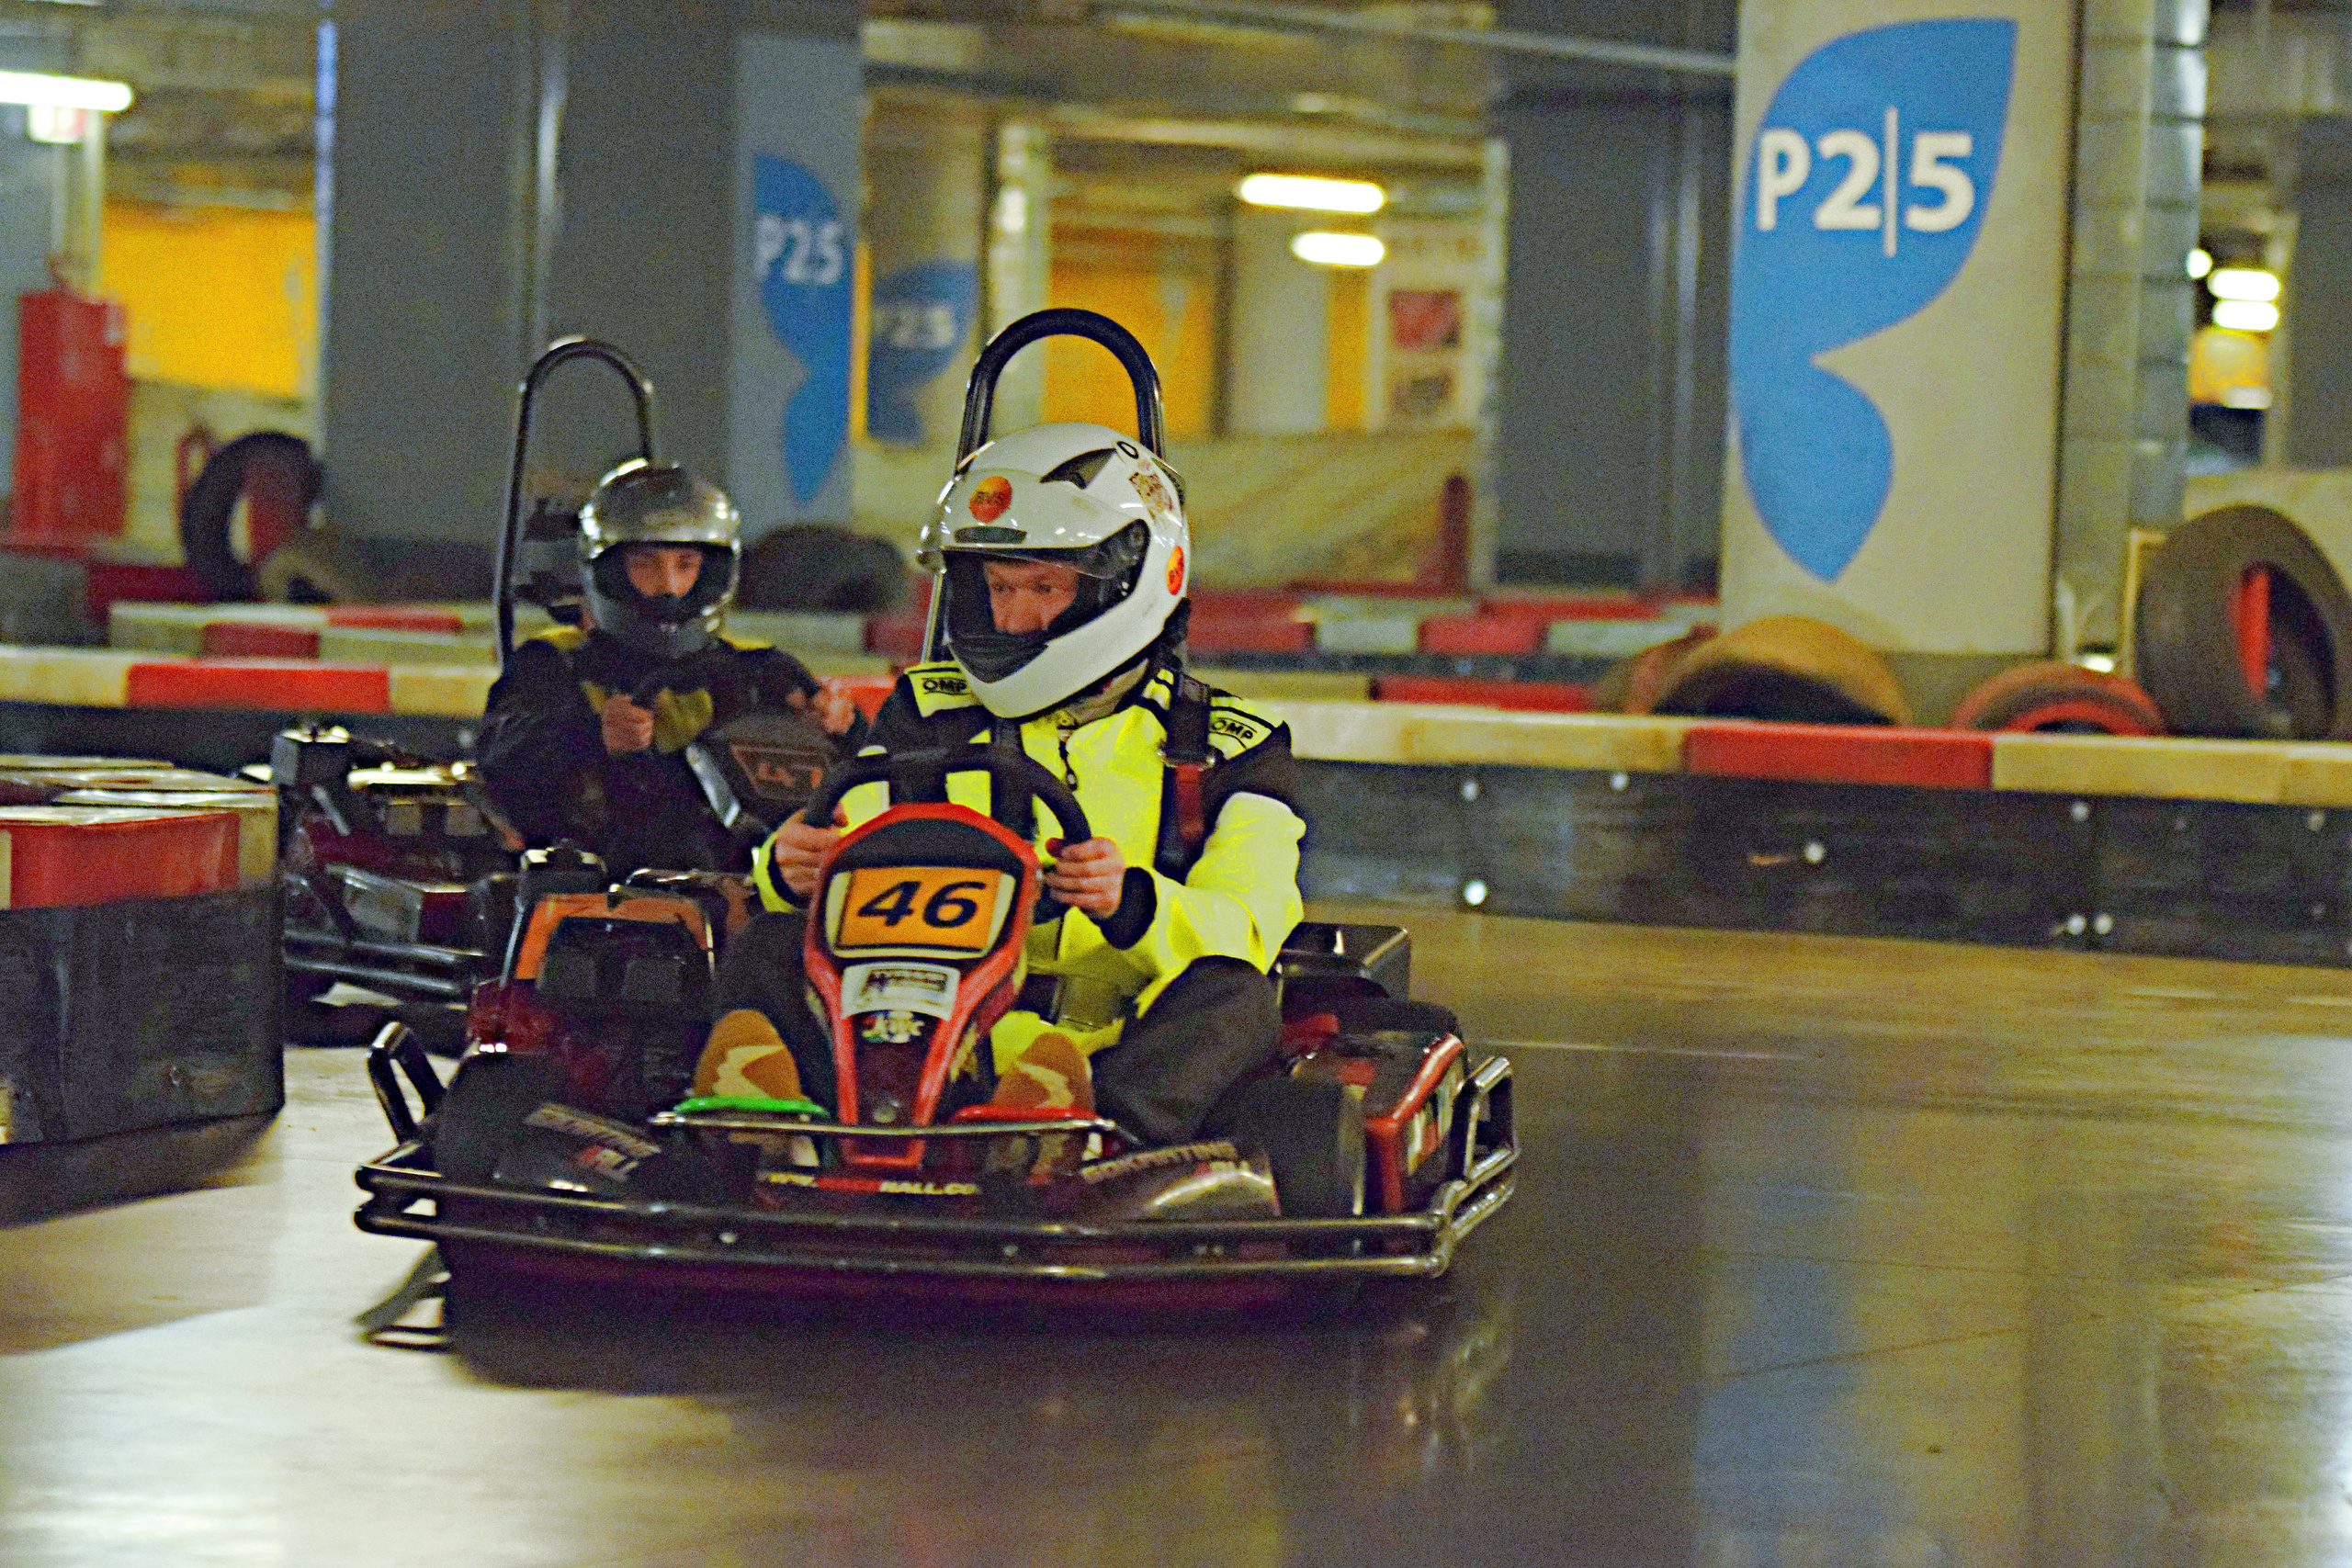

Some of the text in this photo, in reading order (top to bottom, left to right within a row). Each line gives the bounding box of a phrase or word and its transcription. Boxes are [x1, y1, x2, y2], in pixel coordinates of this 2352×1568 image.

[922, 678, 967, 693] OMP
[1211, 719, 1254, 740] OMP
[856, 880, 987, 929] 46
